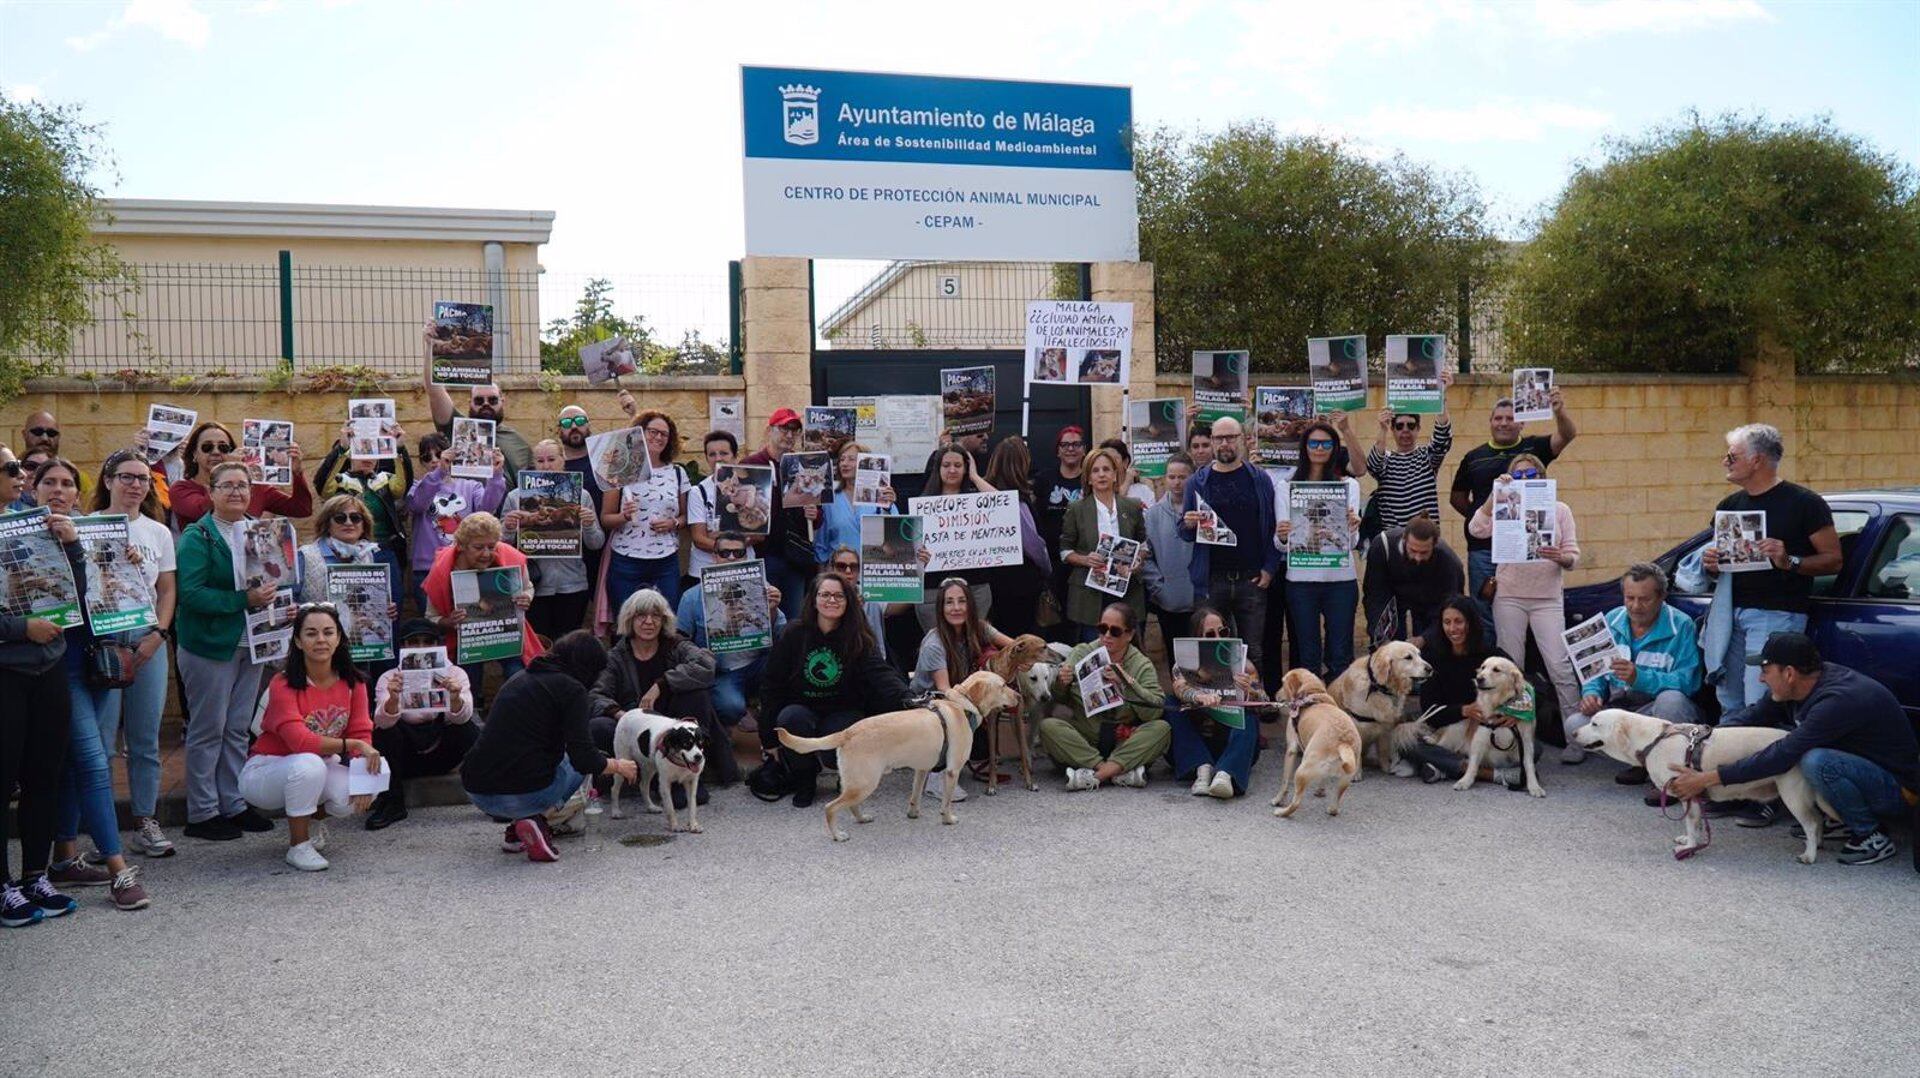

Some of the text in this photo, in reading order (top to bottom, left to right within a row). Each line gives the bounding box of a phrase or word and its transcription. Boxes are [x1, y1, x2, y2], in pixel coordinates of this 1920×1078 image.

[838, 103, 1095, 137] Ayuntamiento de Málaga
[838, 132, 1097, 155] Área de Sostenibilidad Medioambiental
[784, 187, 1101, 207] CENTRO DE PROTECCIÓN ANIMAL MUNICIPAL
[924, 215, 974, 228] CEPAM
[944, 278, 955, 295] 5
[1081, 315, 1115, 324] AMIGA
[1036, 325, 1047, 336] DE
[28, 516, 43, 525] NO
[938, 509, 990, 528] DIMISIÓN
[0, 523, 48, 539] ECTORAS
[924, 526, 1017, 544] ASTA DE MENTIRAS
[461, 617, 518, 630] PERRERA DE
